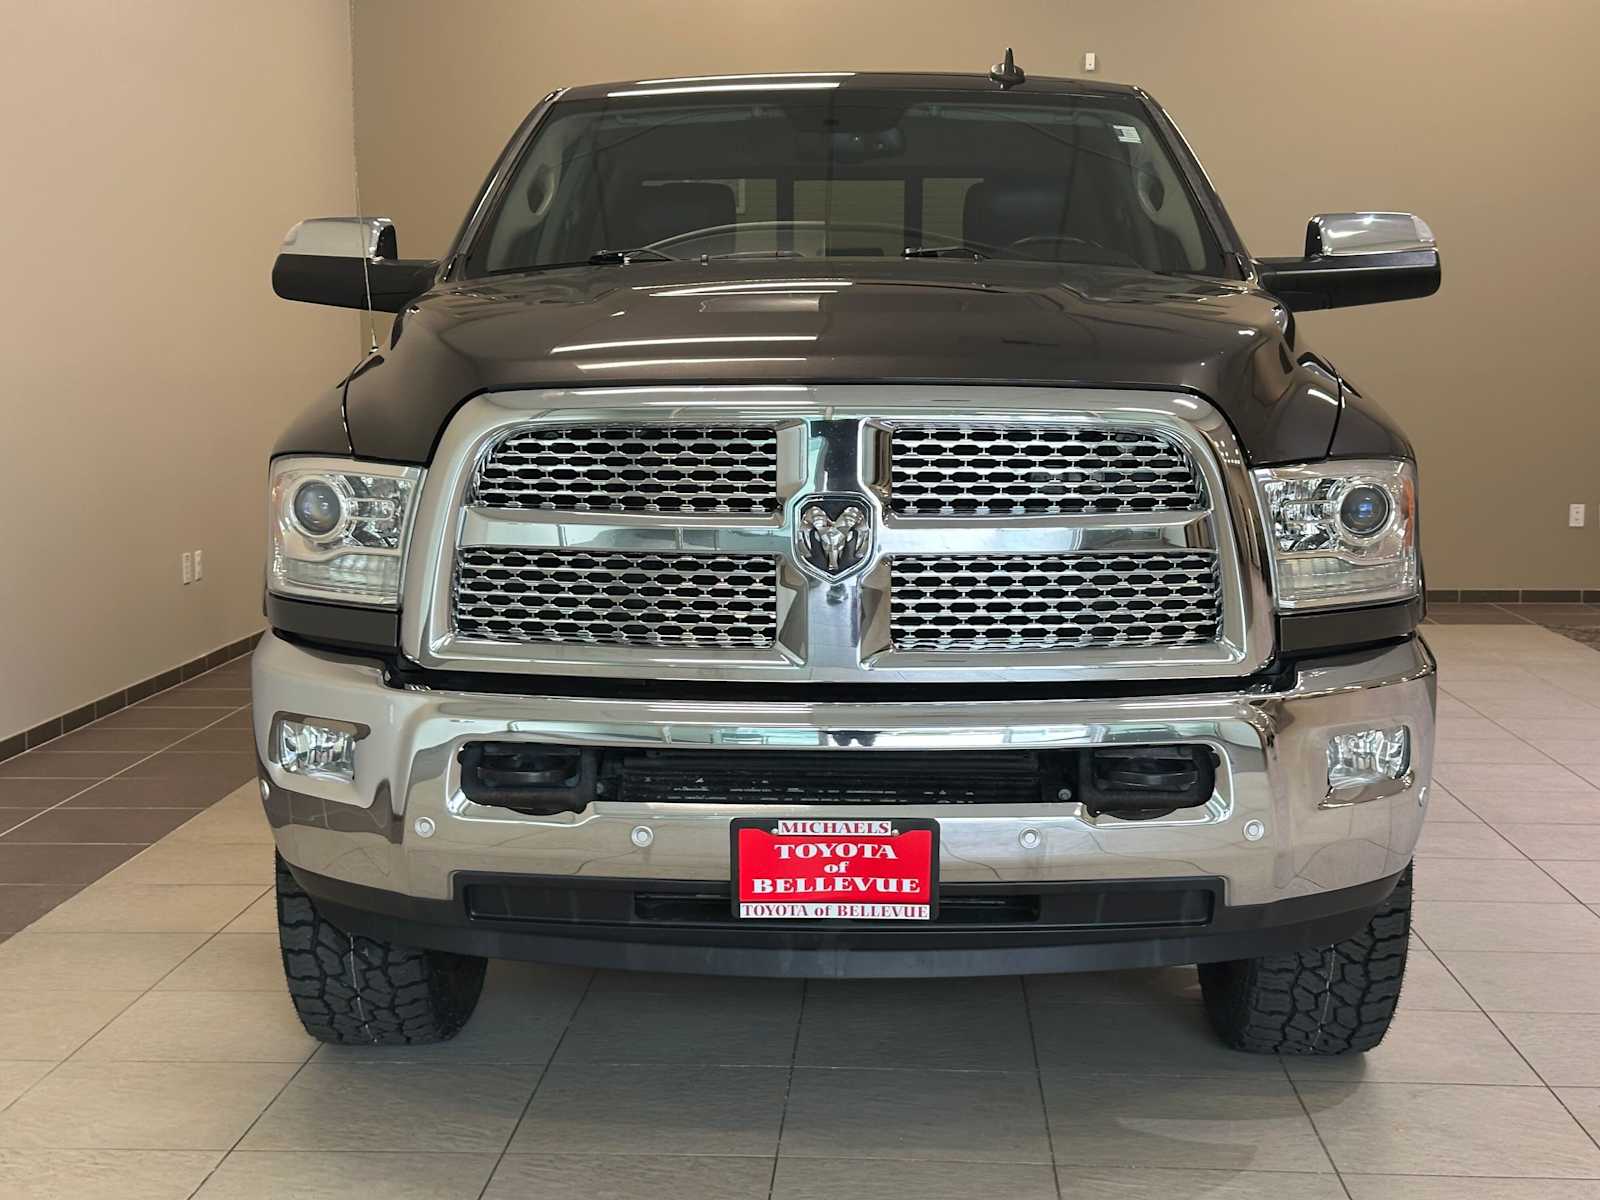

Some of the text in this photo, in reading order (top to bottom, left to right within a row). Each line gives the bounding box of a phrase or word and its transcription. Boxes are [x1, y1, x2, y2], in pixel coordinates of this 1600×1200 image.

[781, 822, 889, 835] MICHAELS
[774, 843, 898, 860] TOYOTA
[824, 861, 850, 874] of
[752, 877, 920, 894] BELLEVUE
[742, 904, 929, 918] TOYOTA of BELLEVUE
